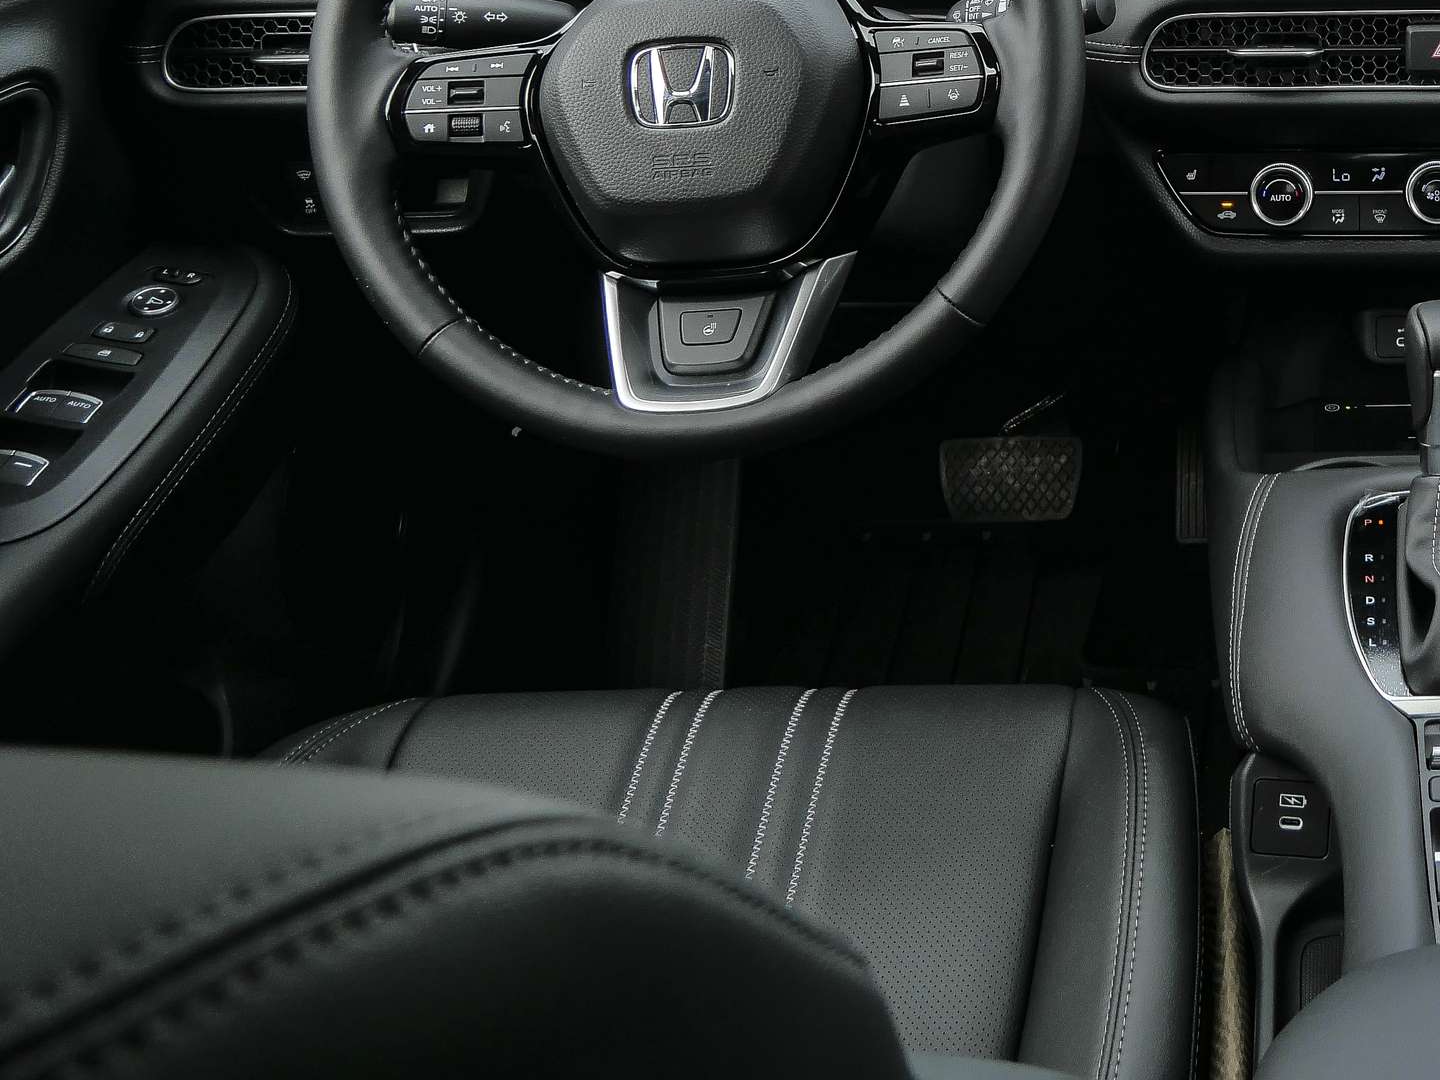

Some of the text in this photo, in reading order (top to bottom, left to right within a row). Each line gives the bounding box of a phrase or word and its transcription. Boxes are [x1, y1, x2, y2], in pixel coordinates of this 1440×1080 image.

[968, 5, 981, 13] OFF
[927, 36, 951, 45] CANCEL
[1332, 168, 1350, 182] Lo
[1270, 194, 1292, 202] AUTO
[67, 399, 92, 410] AUTO
[1364, 519, 1373, 527] P
[1364, 554, 1374, 562] R
[1364, 575, 1375, 583] N
[1365, 596, 1376, 605] D
[1366, 617, 1376, 626] S
[1368, 638, 1377, 647] L
